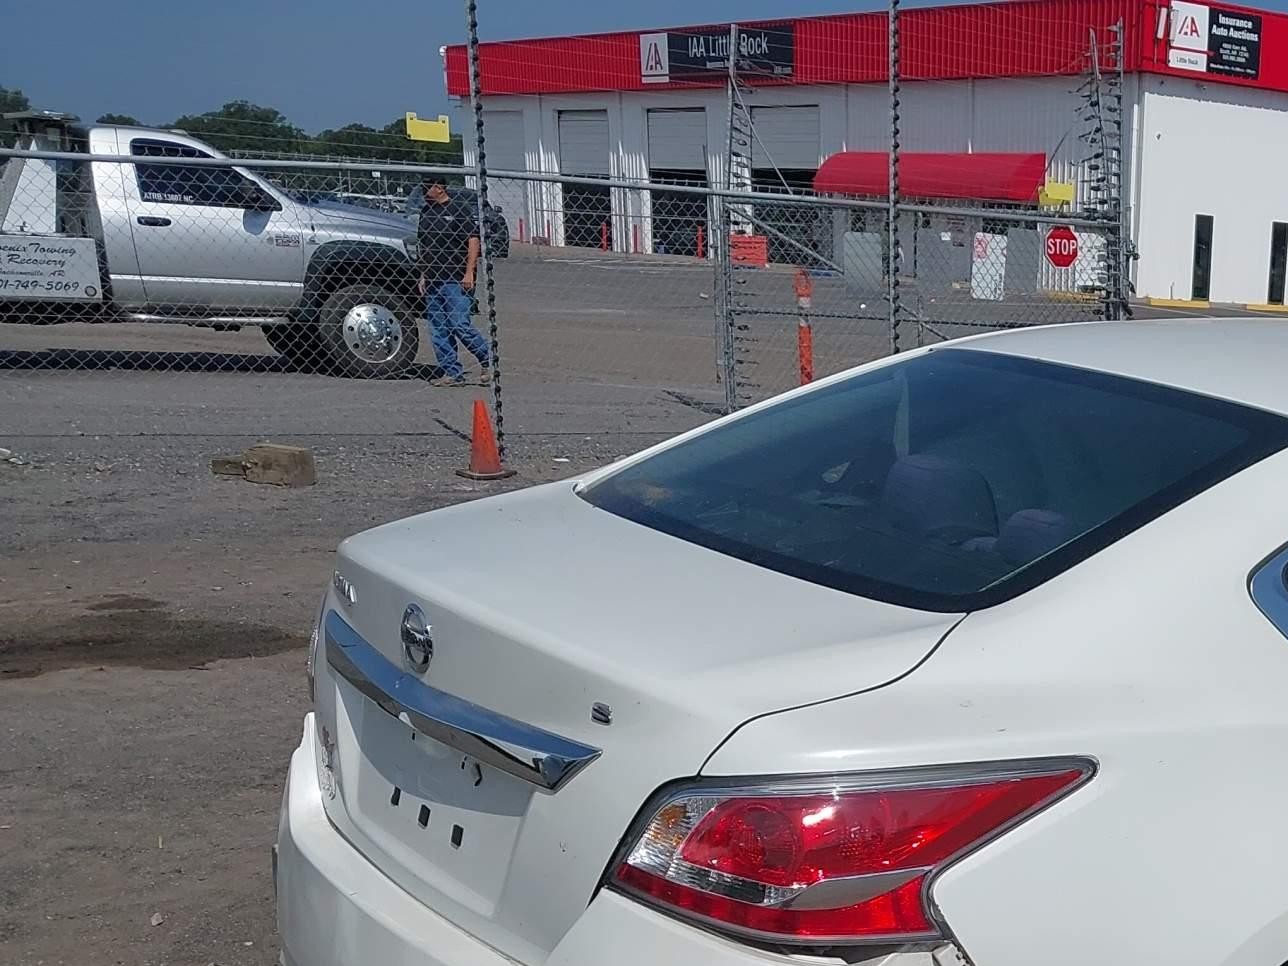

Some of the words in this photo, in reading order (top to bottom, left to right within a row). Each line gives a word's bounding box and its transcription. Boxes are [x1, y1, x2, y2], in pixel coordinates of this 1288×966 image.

[1218, 13, 1253, 29] Insurance
[1211, 24, 1229, 37] Auto
[1228, 27, 1259, 42] Auctions
[688, 36, 706, 58] IAA
[709, 35, 734, 57] Littl
[29, 242, 76, 257] Towing
[1047, 238, 1077, 256] STOP
[7, 254, 66, 268] Recovery
